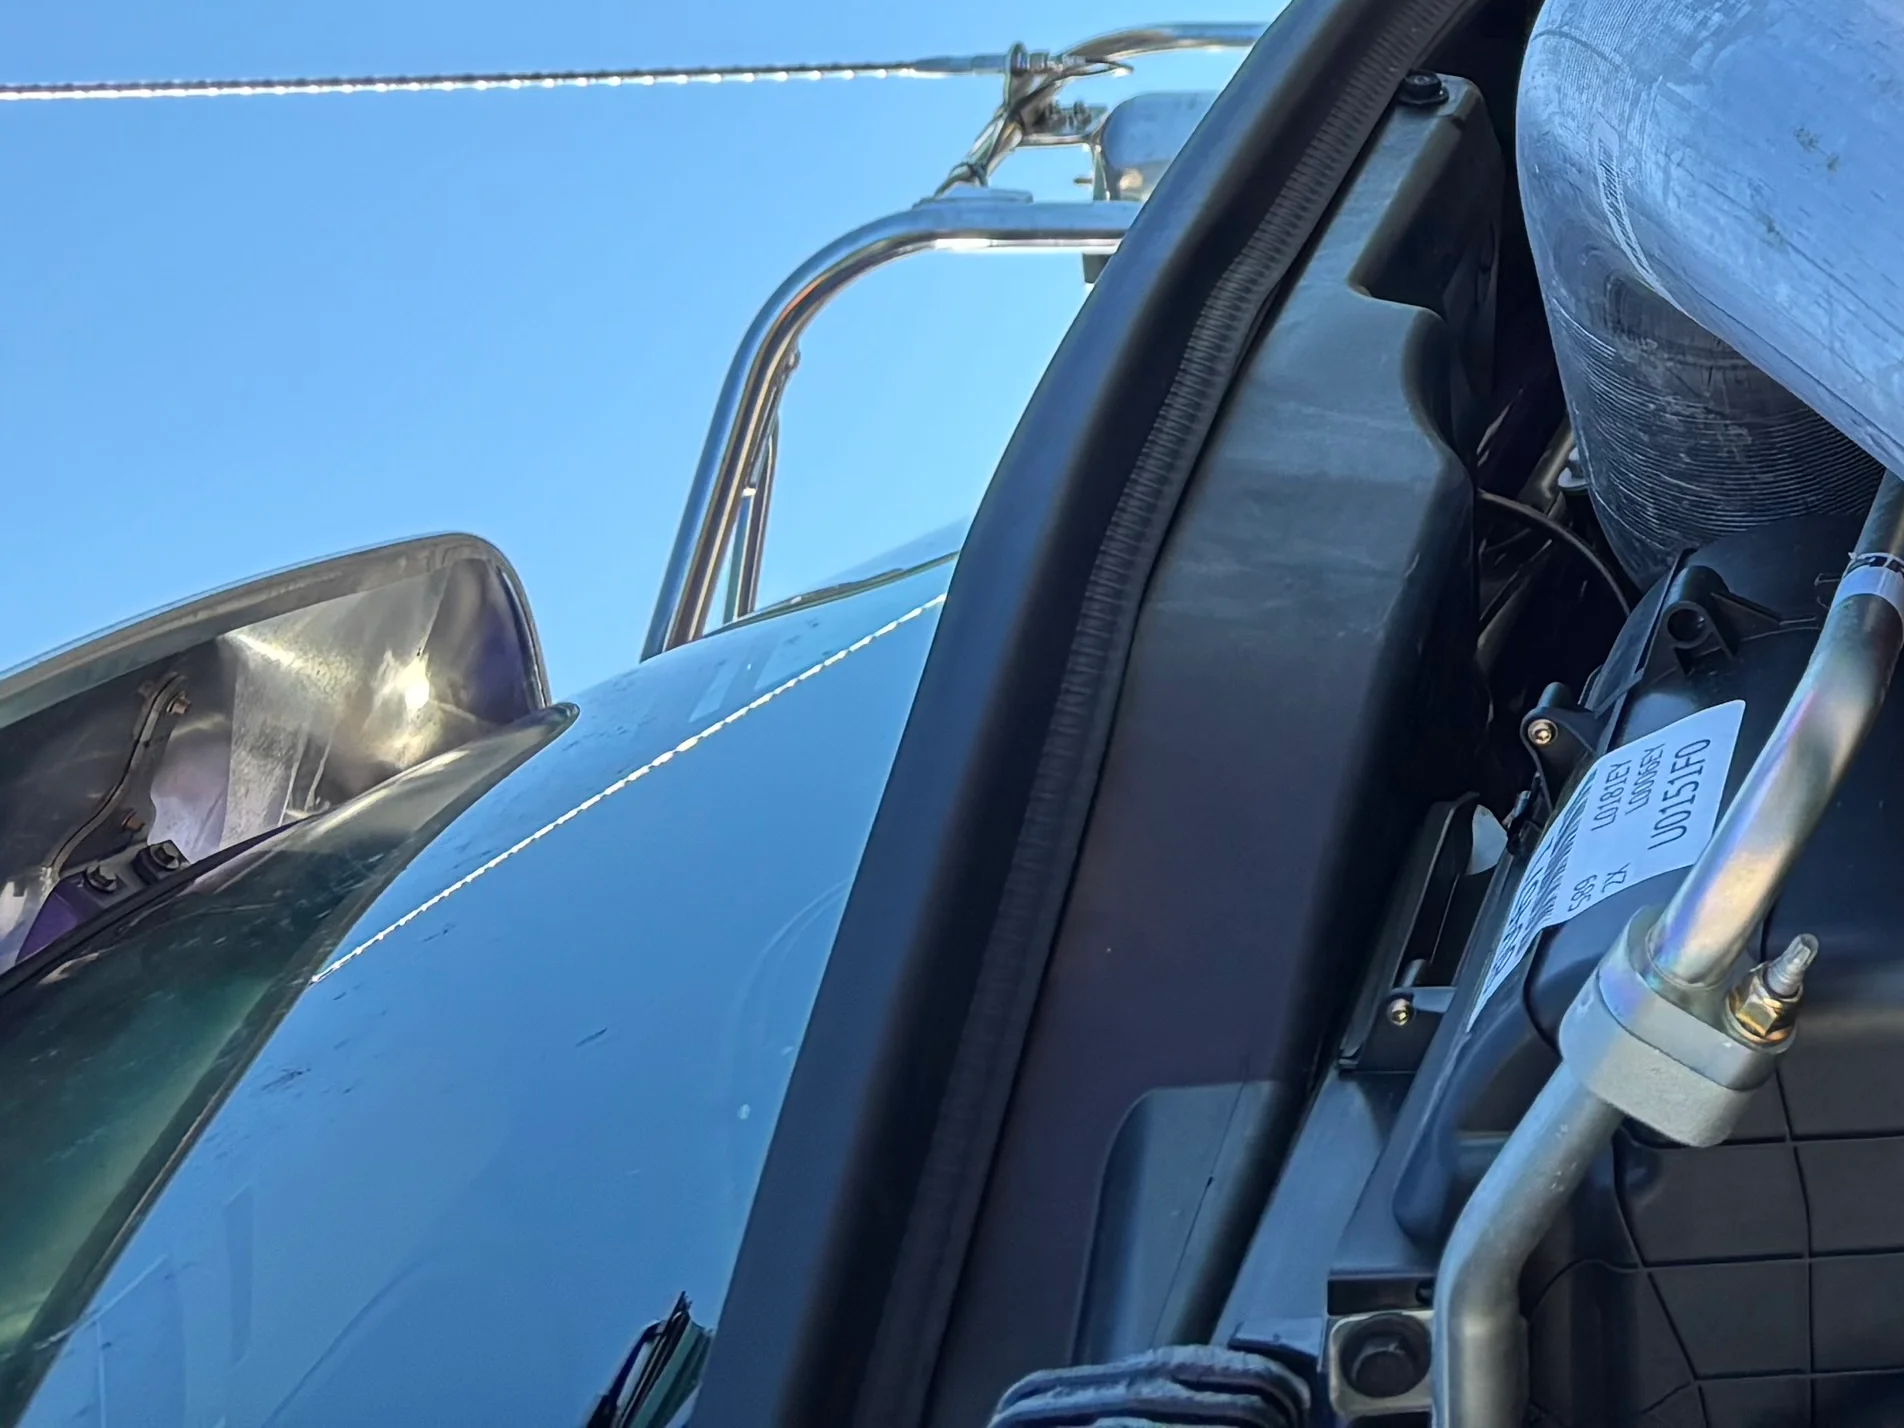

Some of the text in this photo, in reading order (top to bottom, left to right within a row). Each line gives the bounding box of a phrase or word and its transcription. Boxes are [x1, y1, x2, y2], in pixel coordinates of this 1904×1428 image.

[1567, 757, 1633, 914] 589 L0181EY
[1601, 742, 1667, 897] 2X L0006EY
[1646, 738, 1713, 843] U0151F0
